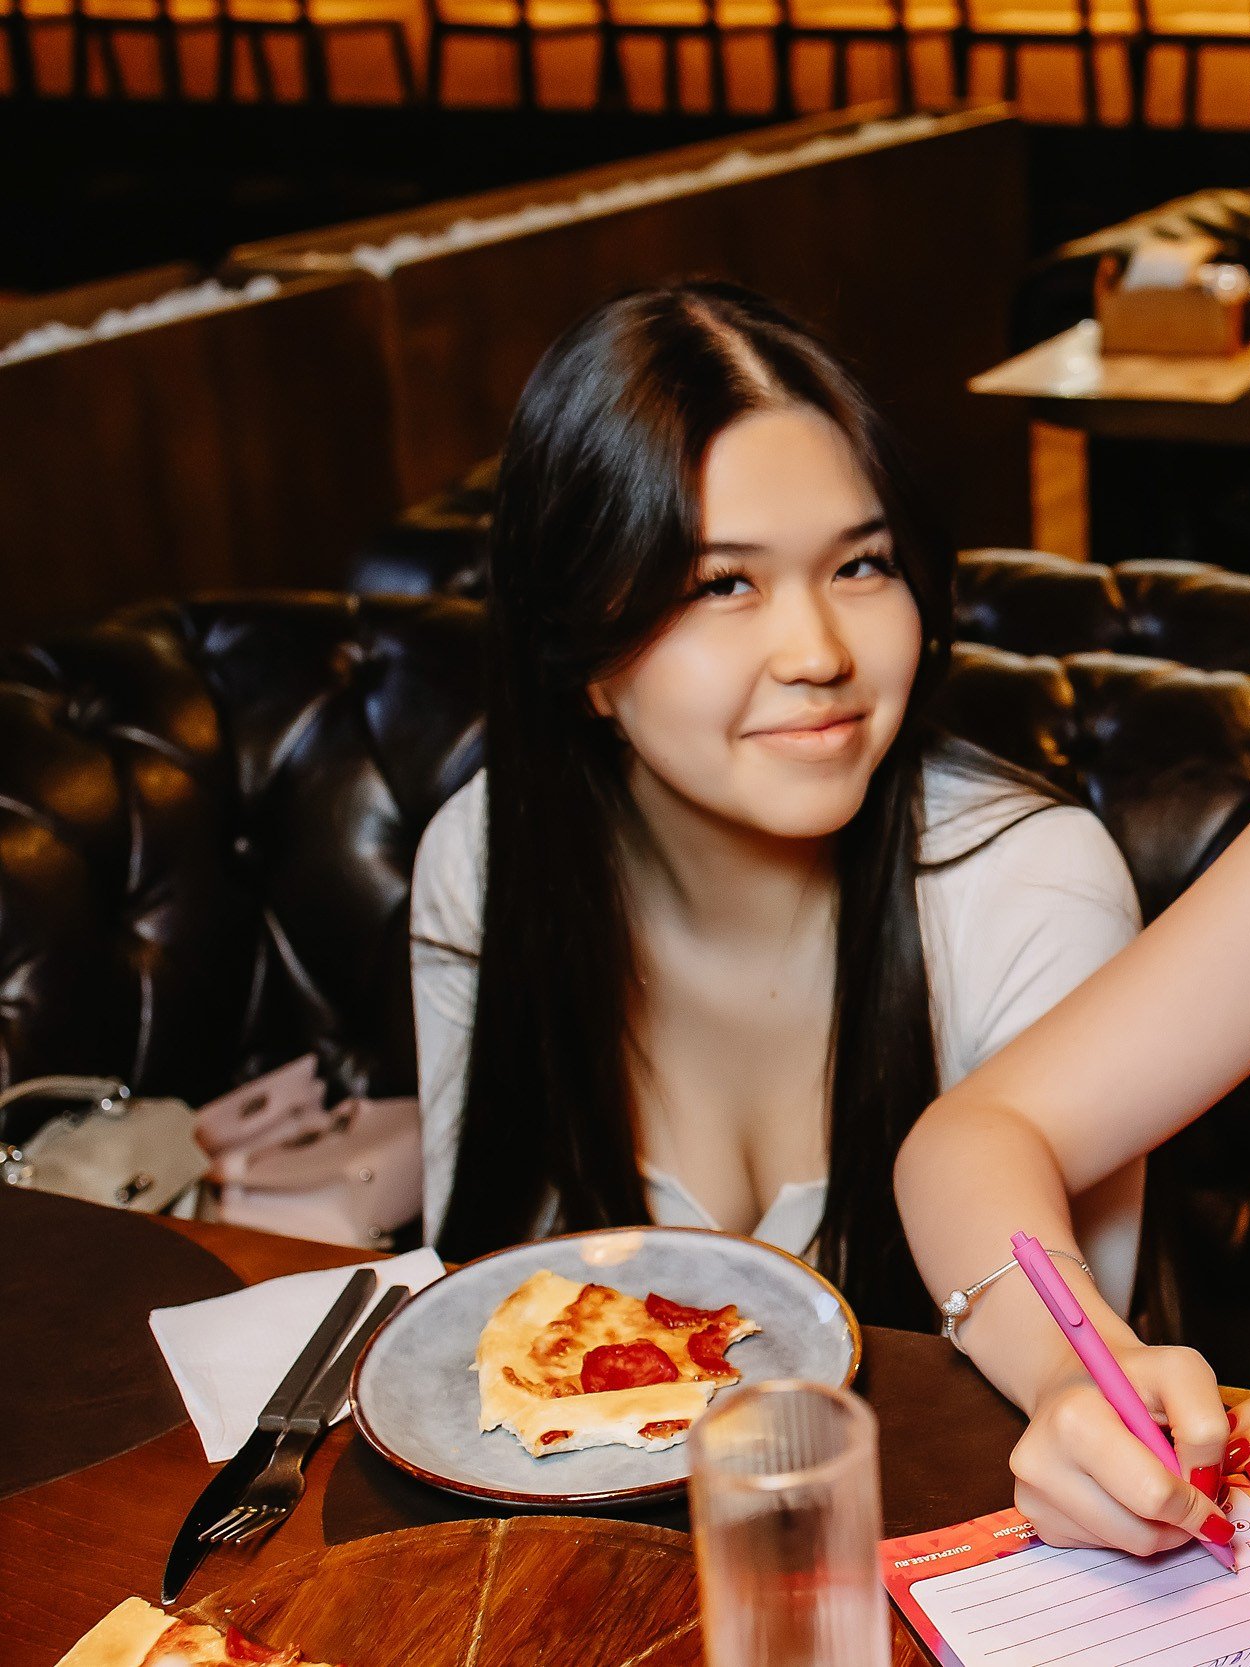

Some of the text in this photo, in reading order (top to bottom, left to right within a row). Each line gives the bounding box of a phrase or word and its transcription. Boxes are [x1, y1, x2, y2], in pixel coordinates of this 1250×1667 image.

[992, 1522, 1033, 1539] ОКОДЫ
[1236, 1521, 1246, 1530] 9
[894, 1544, 972, 1569] QUIZPLEASE.RU
